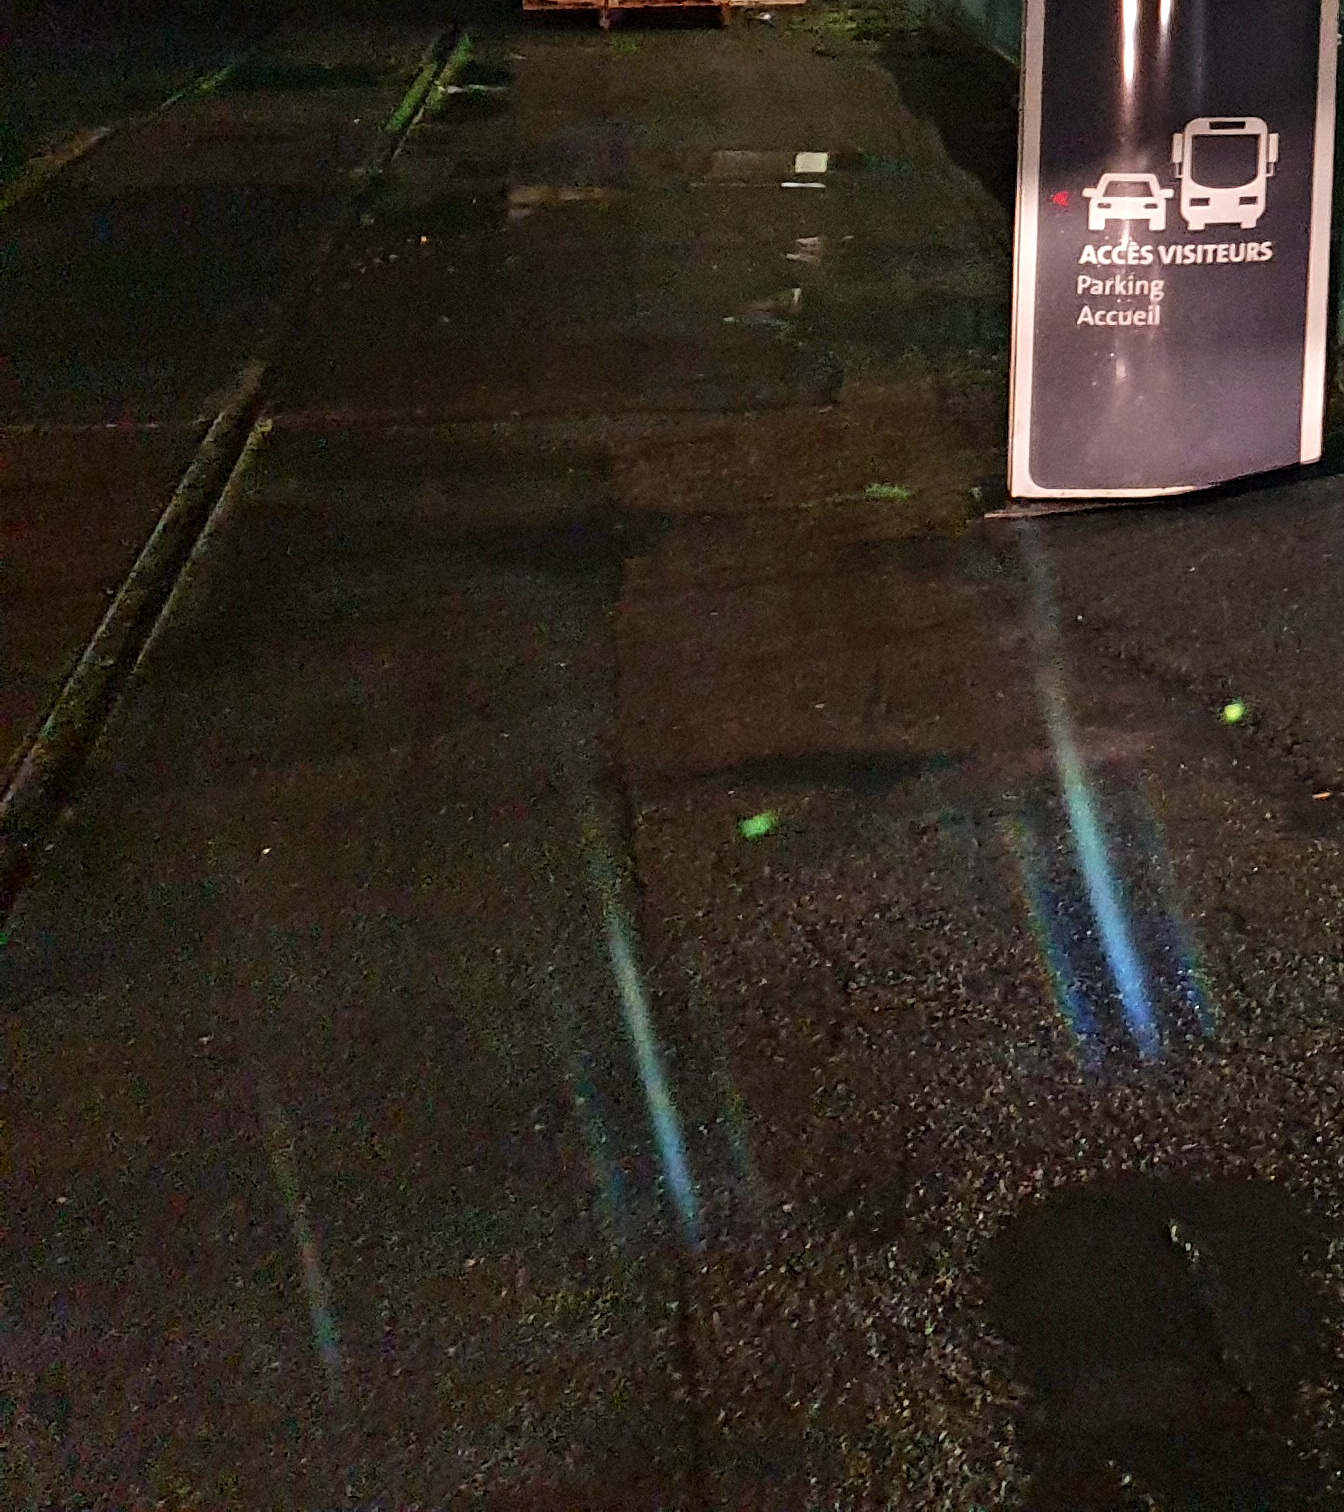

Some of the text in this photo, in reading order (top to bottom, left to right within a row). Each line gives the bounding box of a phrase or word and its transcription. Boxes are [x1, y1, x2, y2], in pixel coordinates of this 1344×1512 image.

[1078, 240, 1274, 265] ACCÈS VISITEURS
[1076, 274, 1165, 302] Parking
[1076, 304, 1161, 327] Accueil
